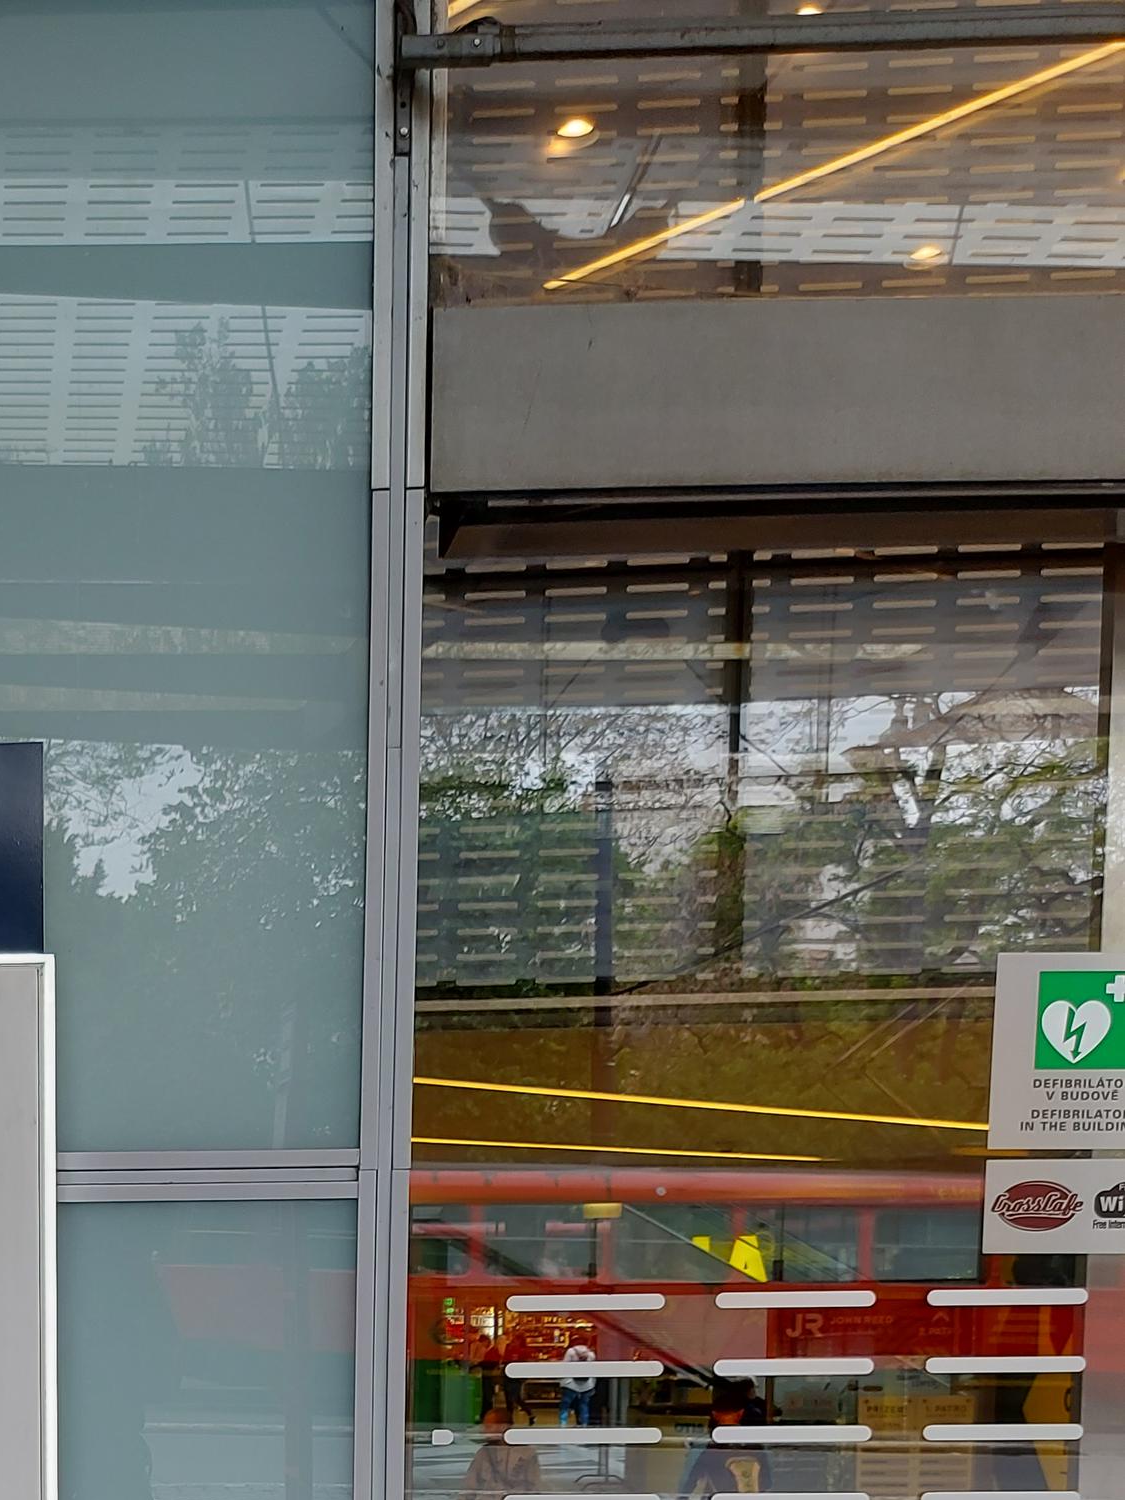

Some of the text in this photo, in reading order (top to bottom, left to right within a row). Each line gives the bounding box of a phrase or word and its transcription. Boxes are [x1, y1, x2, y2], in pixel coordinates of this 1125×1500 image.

[1046, 1091, 1055, 1100] V
[1031, 1109, 1125, 1119] DEFIBRILATO
[1020, 1121, 1034, 1131] IN
[1040, 1121, 1067, 1131] THE
[991, 1193, 1084, 1216] CrossCafe
